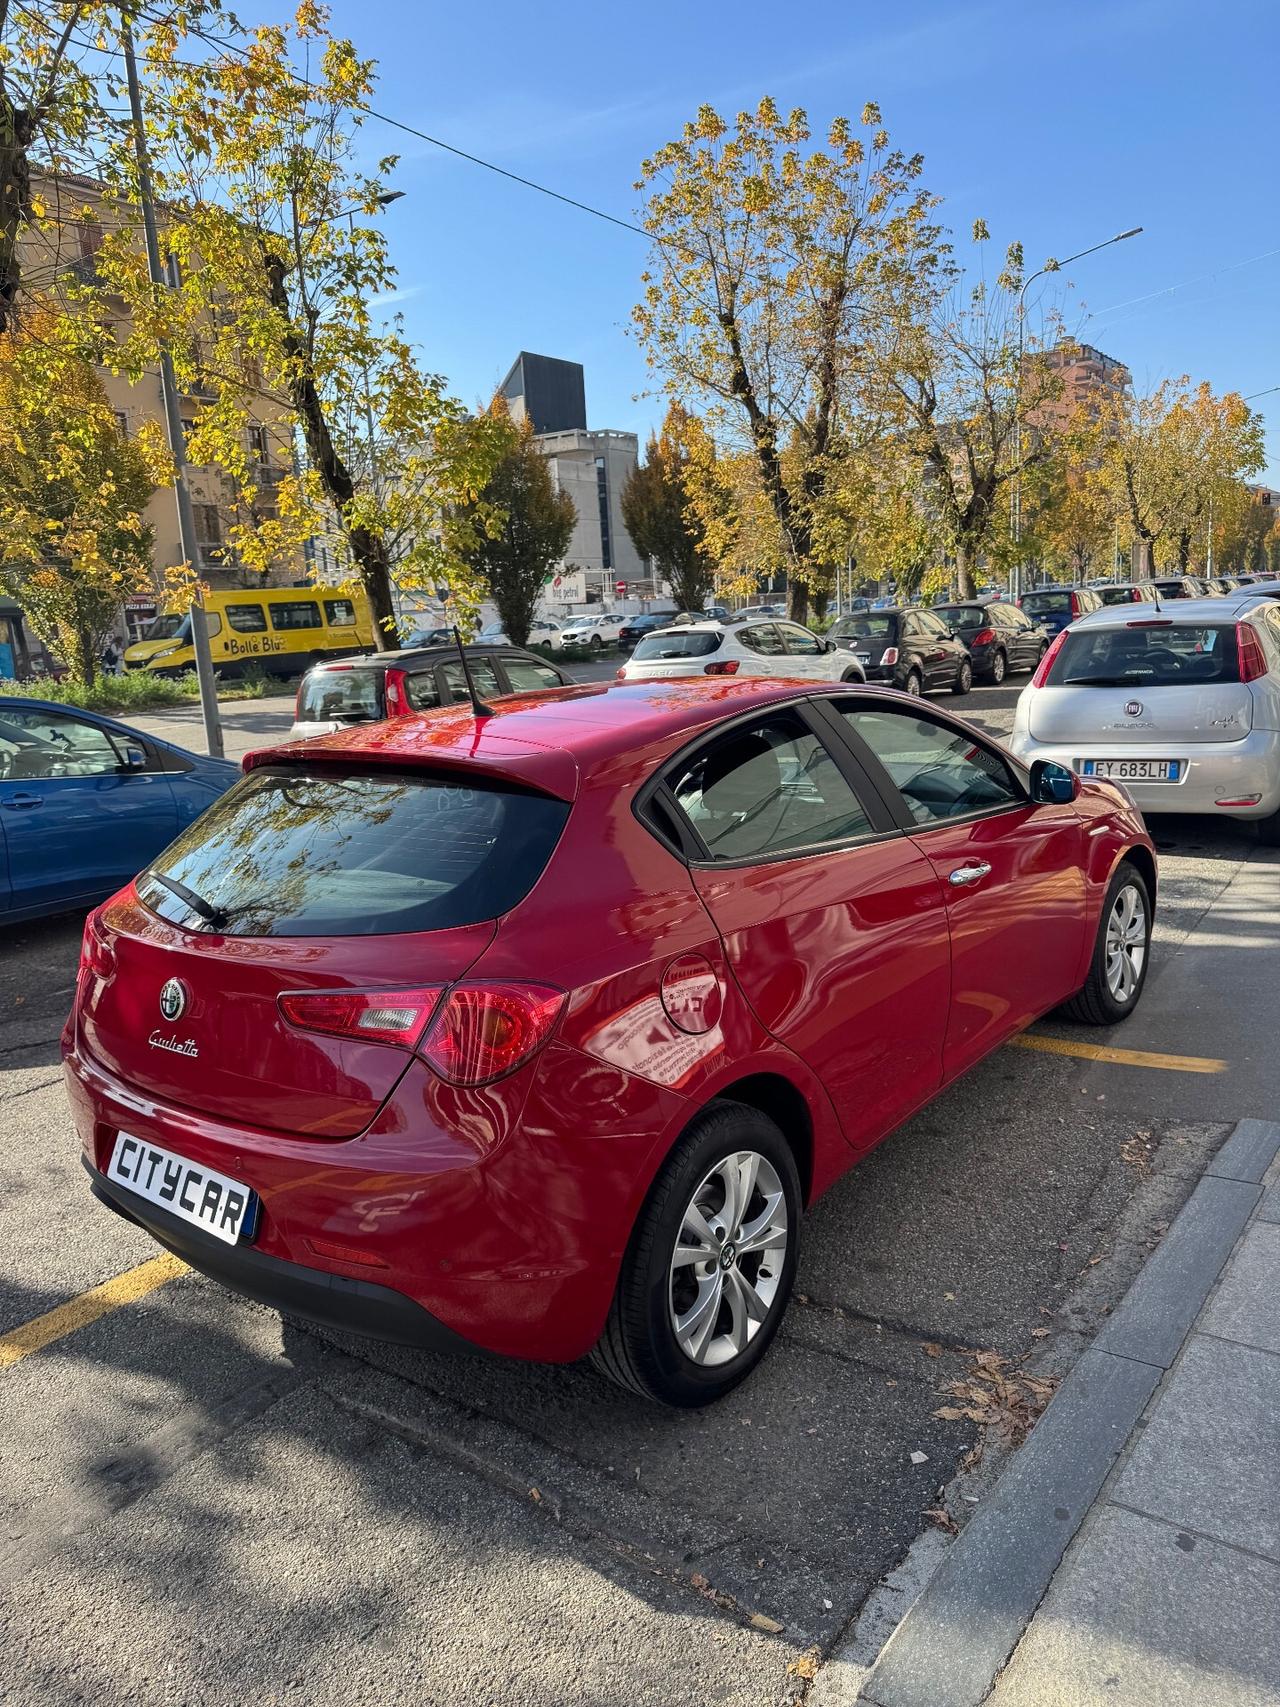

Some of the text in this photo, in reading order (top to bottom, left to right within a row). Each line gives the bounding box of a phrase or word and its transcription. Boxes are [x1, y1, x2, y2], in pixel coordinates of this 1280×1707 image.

[230, 637, 280, 654] Bolle Blu
[1096, 763, 1168, 778] EY 683LH
[148, 1029, 199, 1058] Giulietta
[115, 1137, 245, 1236] CITYCAR
